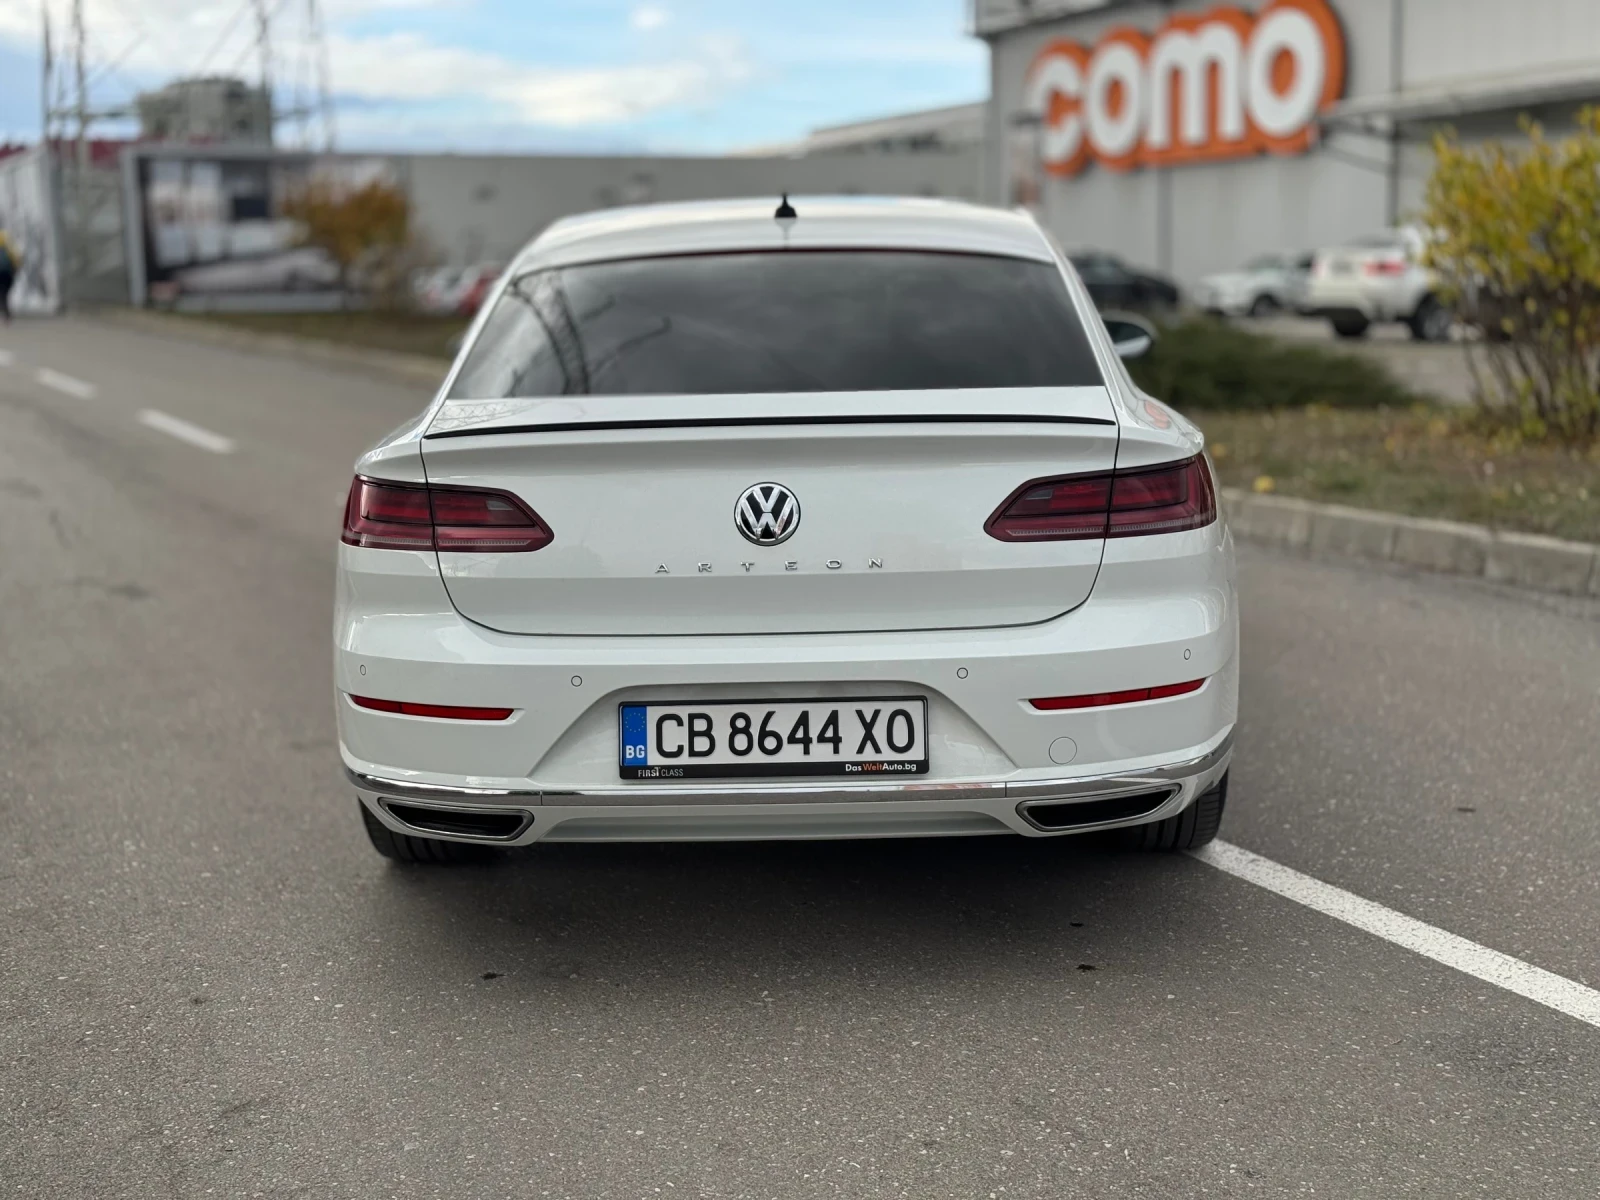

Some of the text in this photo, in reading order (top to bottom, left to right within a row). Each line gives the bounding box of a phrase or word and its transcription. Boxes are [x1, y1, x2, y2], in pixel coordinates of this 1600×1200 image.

[735, 482, 801, 546] VW
[655, 557, 883, 574] ARTEON
[655, 712, 716, 758] CB
[728, 709, 843, 756] 8644
[625, 744, 645, 759] BG
[637, 766, 684, 777] FIRST CLASS
[845, 763, 862, 772] Das
